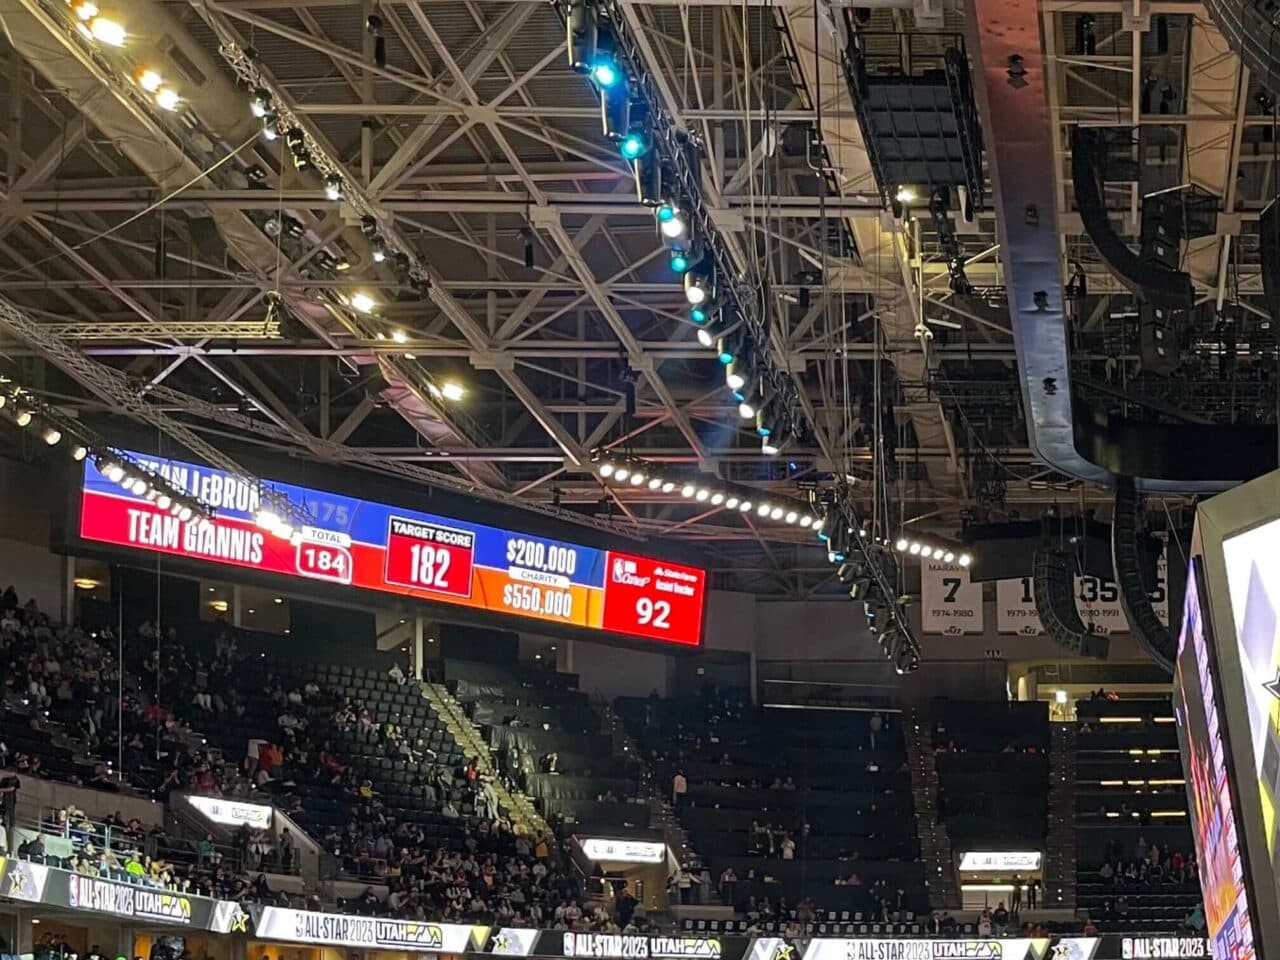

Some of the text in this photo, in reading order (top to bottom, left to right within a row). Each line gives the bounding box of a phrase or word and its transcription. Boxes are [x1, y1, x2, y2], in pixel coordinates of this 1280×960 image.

[128, 509, 264, 564] TEAM GIANNIS
[311, 530, 341, 543] TOTAL
[393, 521, 471, 547] TARGET SCORE
[305, 549, 345, 573] 184
[410, 545, 449, 588] 182
[507, 539, 576, 575] $200,000
[520, 570, 558, 584] CHARITY
[503, 583, 572, 617] $550,000
[943, 578, 961, 602] 7
[1080, 578, 1118, 602] 35
[636, 597, 671, 629] 92
[135, 891, 162, 913] UTAH
[350, 918, 406, 942] 2023 UTAH
[623, 936, 685, 957] 2023 UTAH
[906, 942, 965, 960] 2023 UTAH
[1180, 938, 1204, 957] 2023
